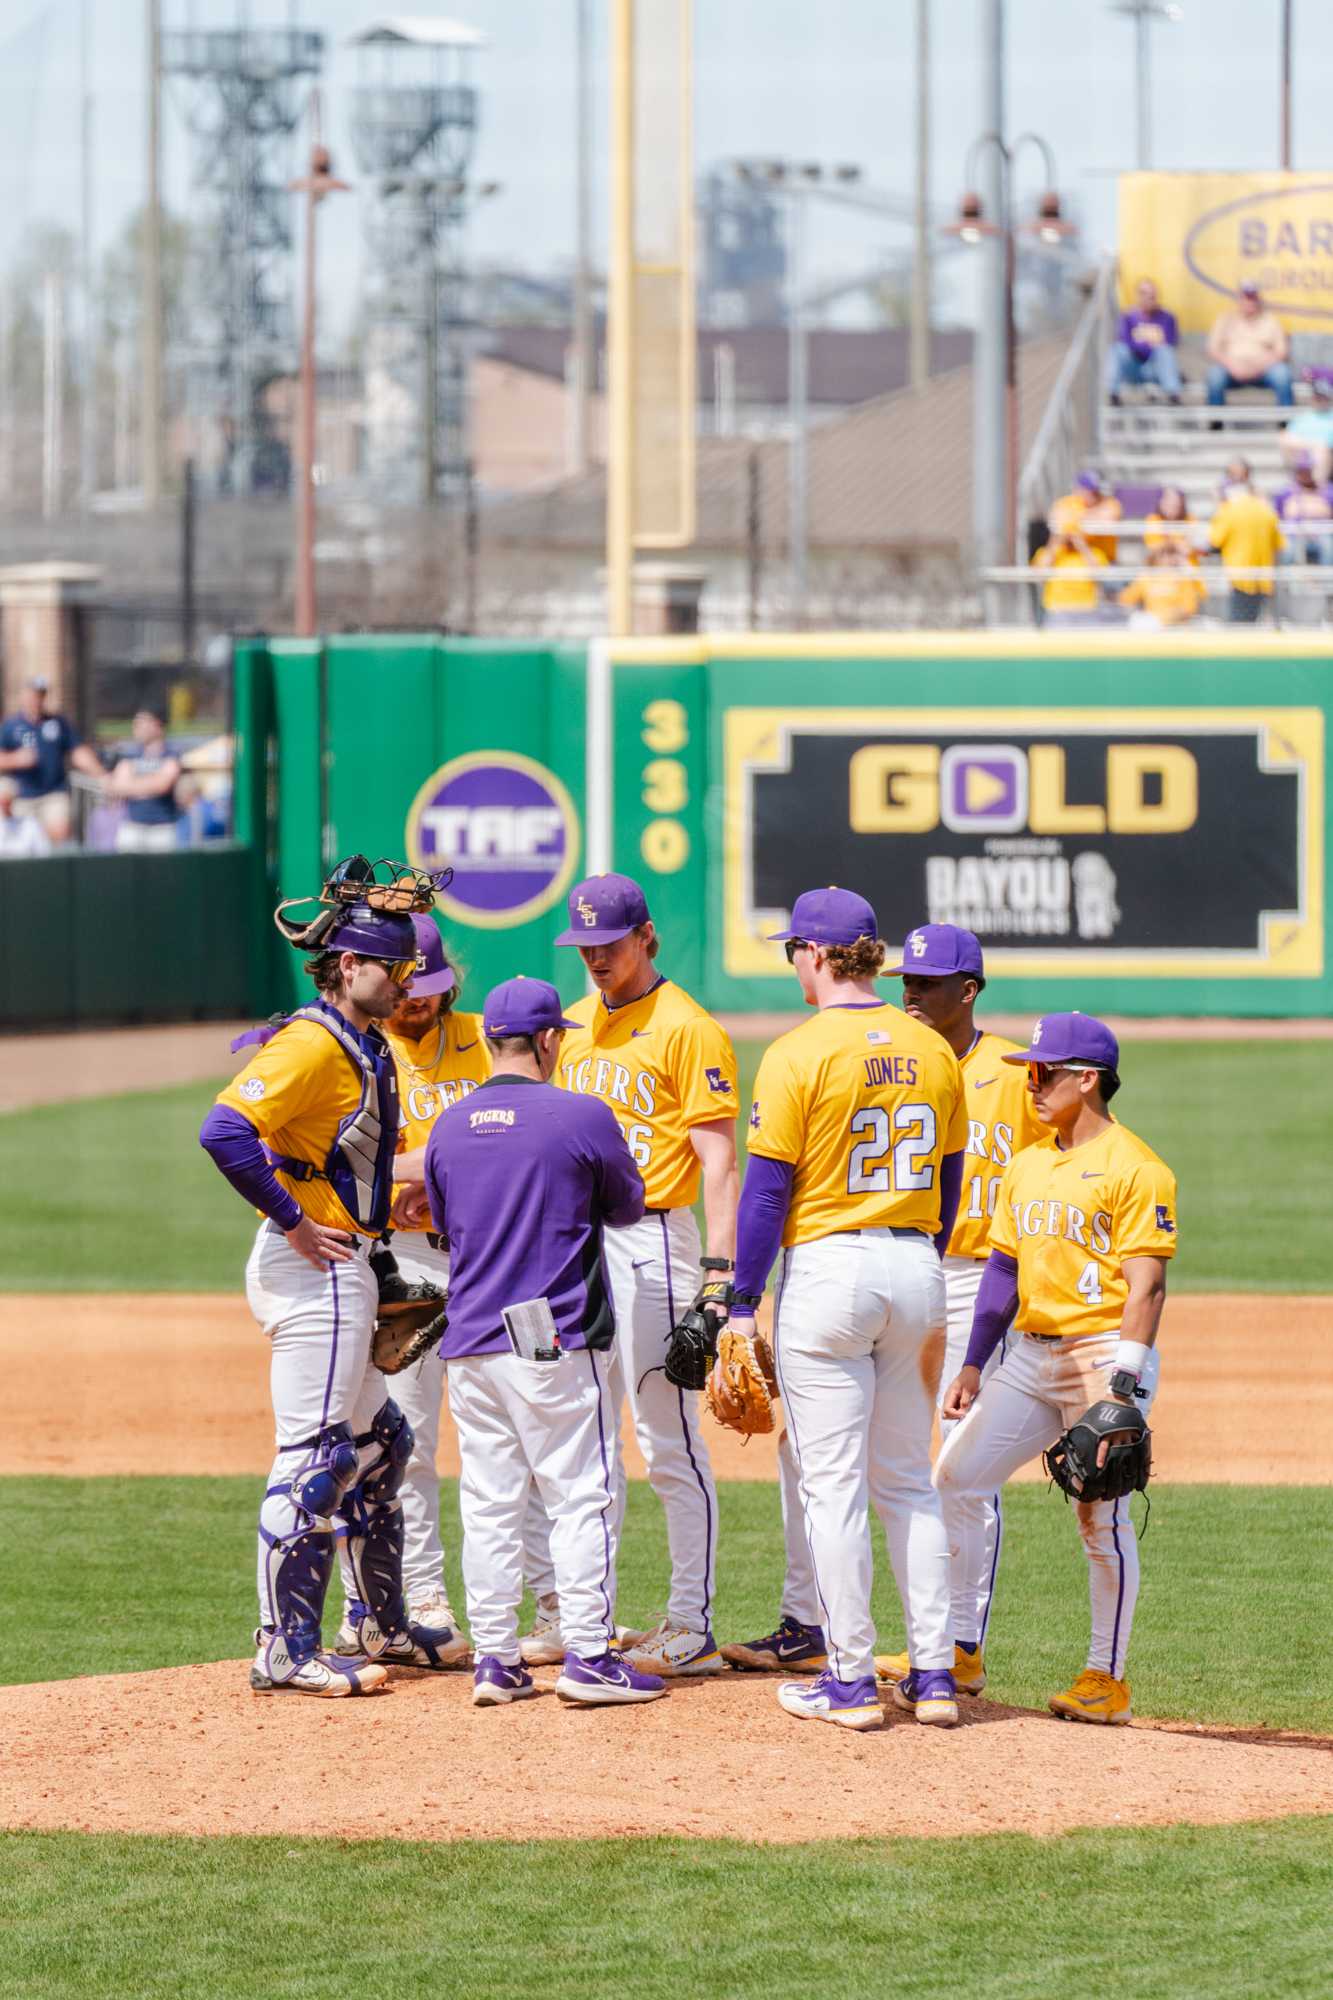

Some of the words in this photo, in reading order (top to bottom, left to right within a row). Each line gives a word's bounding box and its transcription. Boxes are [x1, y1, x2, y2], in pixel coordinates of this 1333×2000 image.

[926, 856, 1070, 909] BAYOU
[562, 1057, 657, 1117] IGERS
[864, 1056, 918, 1087] JONES
[469, 1109, 515, 1129] TIGERS
[618, 1122, 655, 1168] 6
[847, 1103, 937, 1195] 22
[1076, 1261, 1104, 1305] 4
